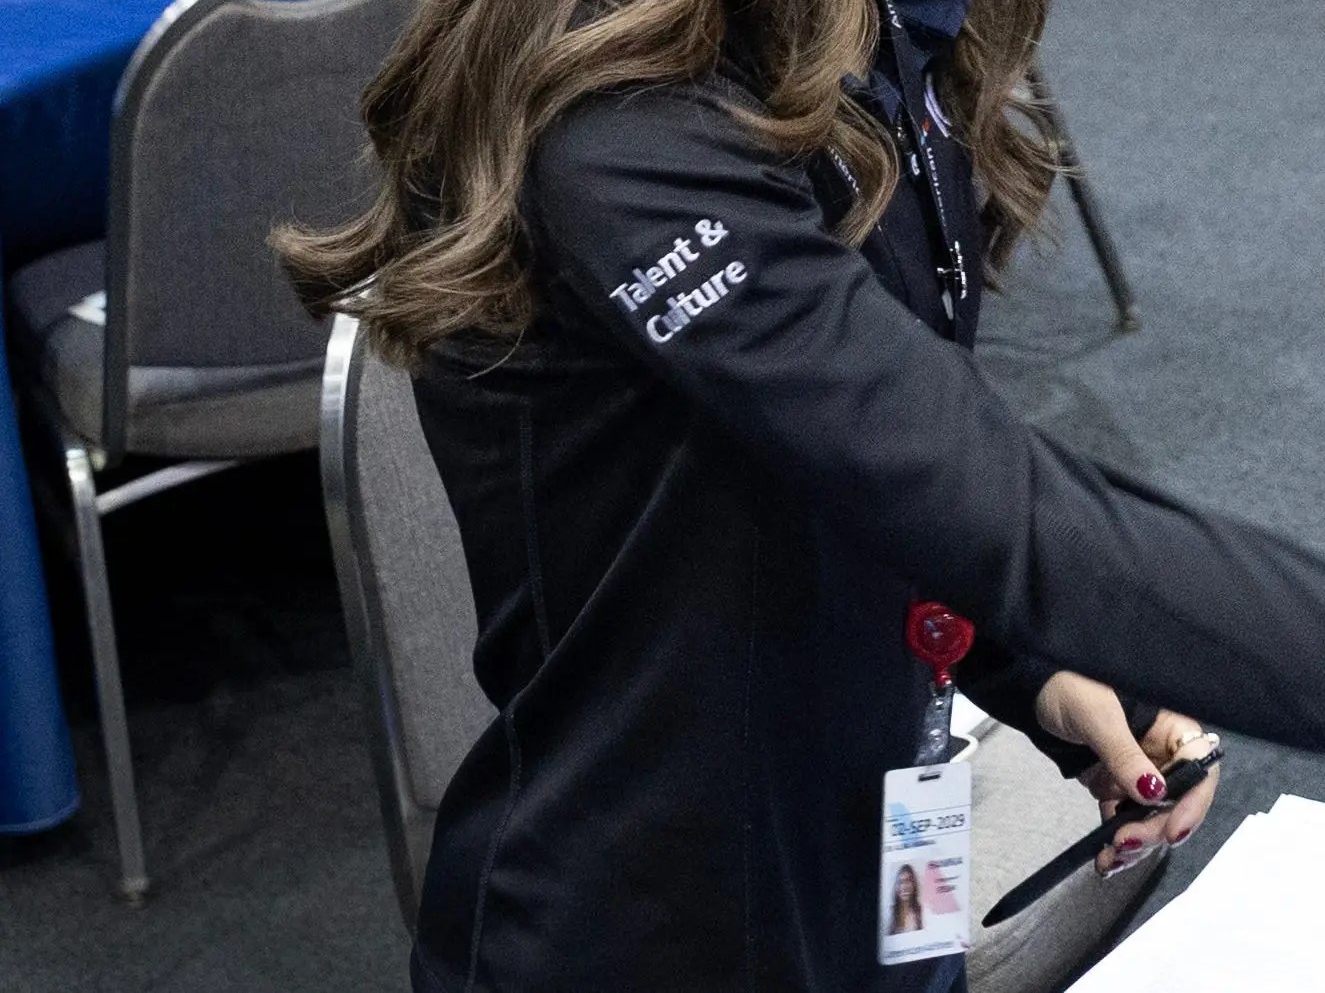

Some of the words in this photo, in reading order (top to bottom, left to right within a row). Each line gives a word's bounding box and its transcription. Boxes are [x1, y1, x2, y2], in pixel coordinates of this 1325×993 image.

[608, 237, 701, 312] Talent
[694, 218, 729, 248] &
[646, 260, 749, 343] Culture
